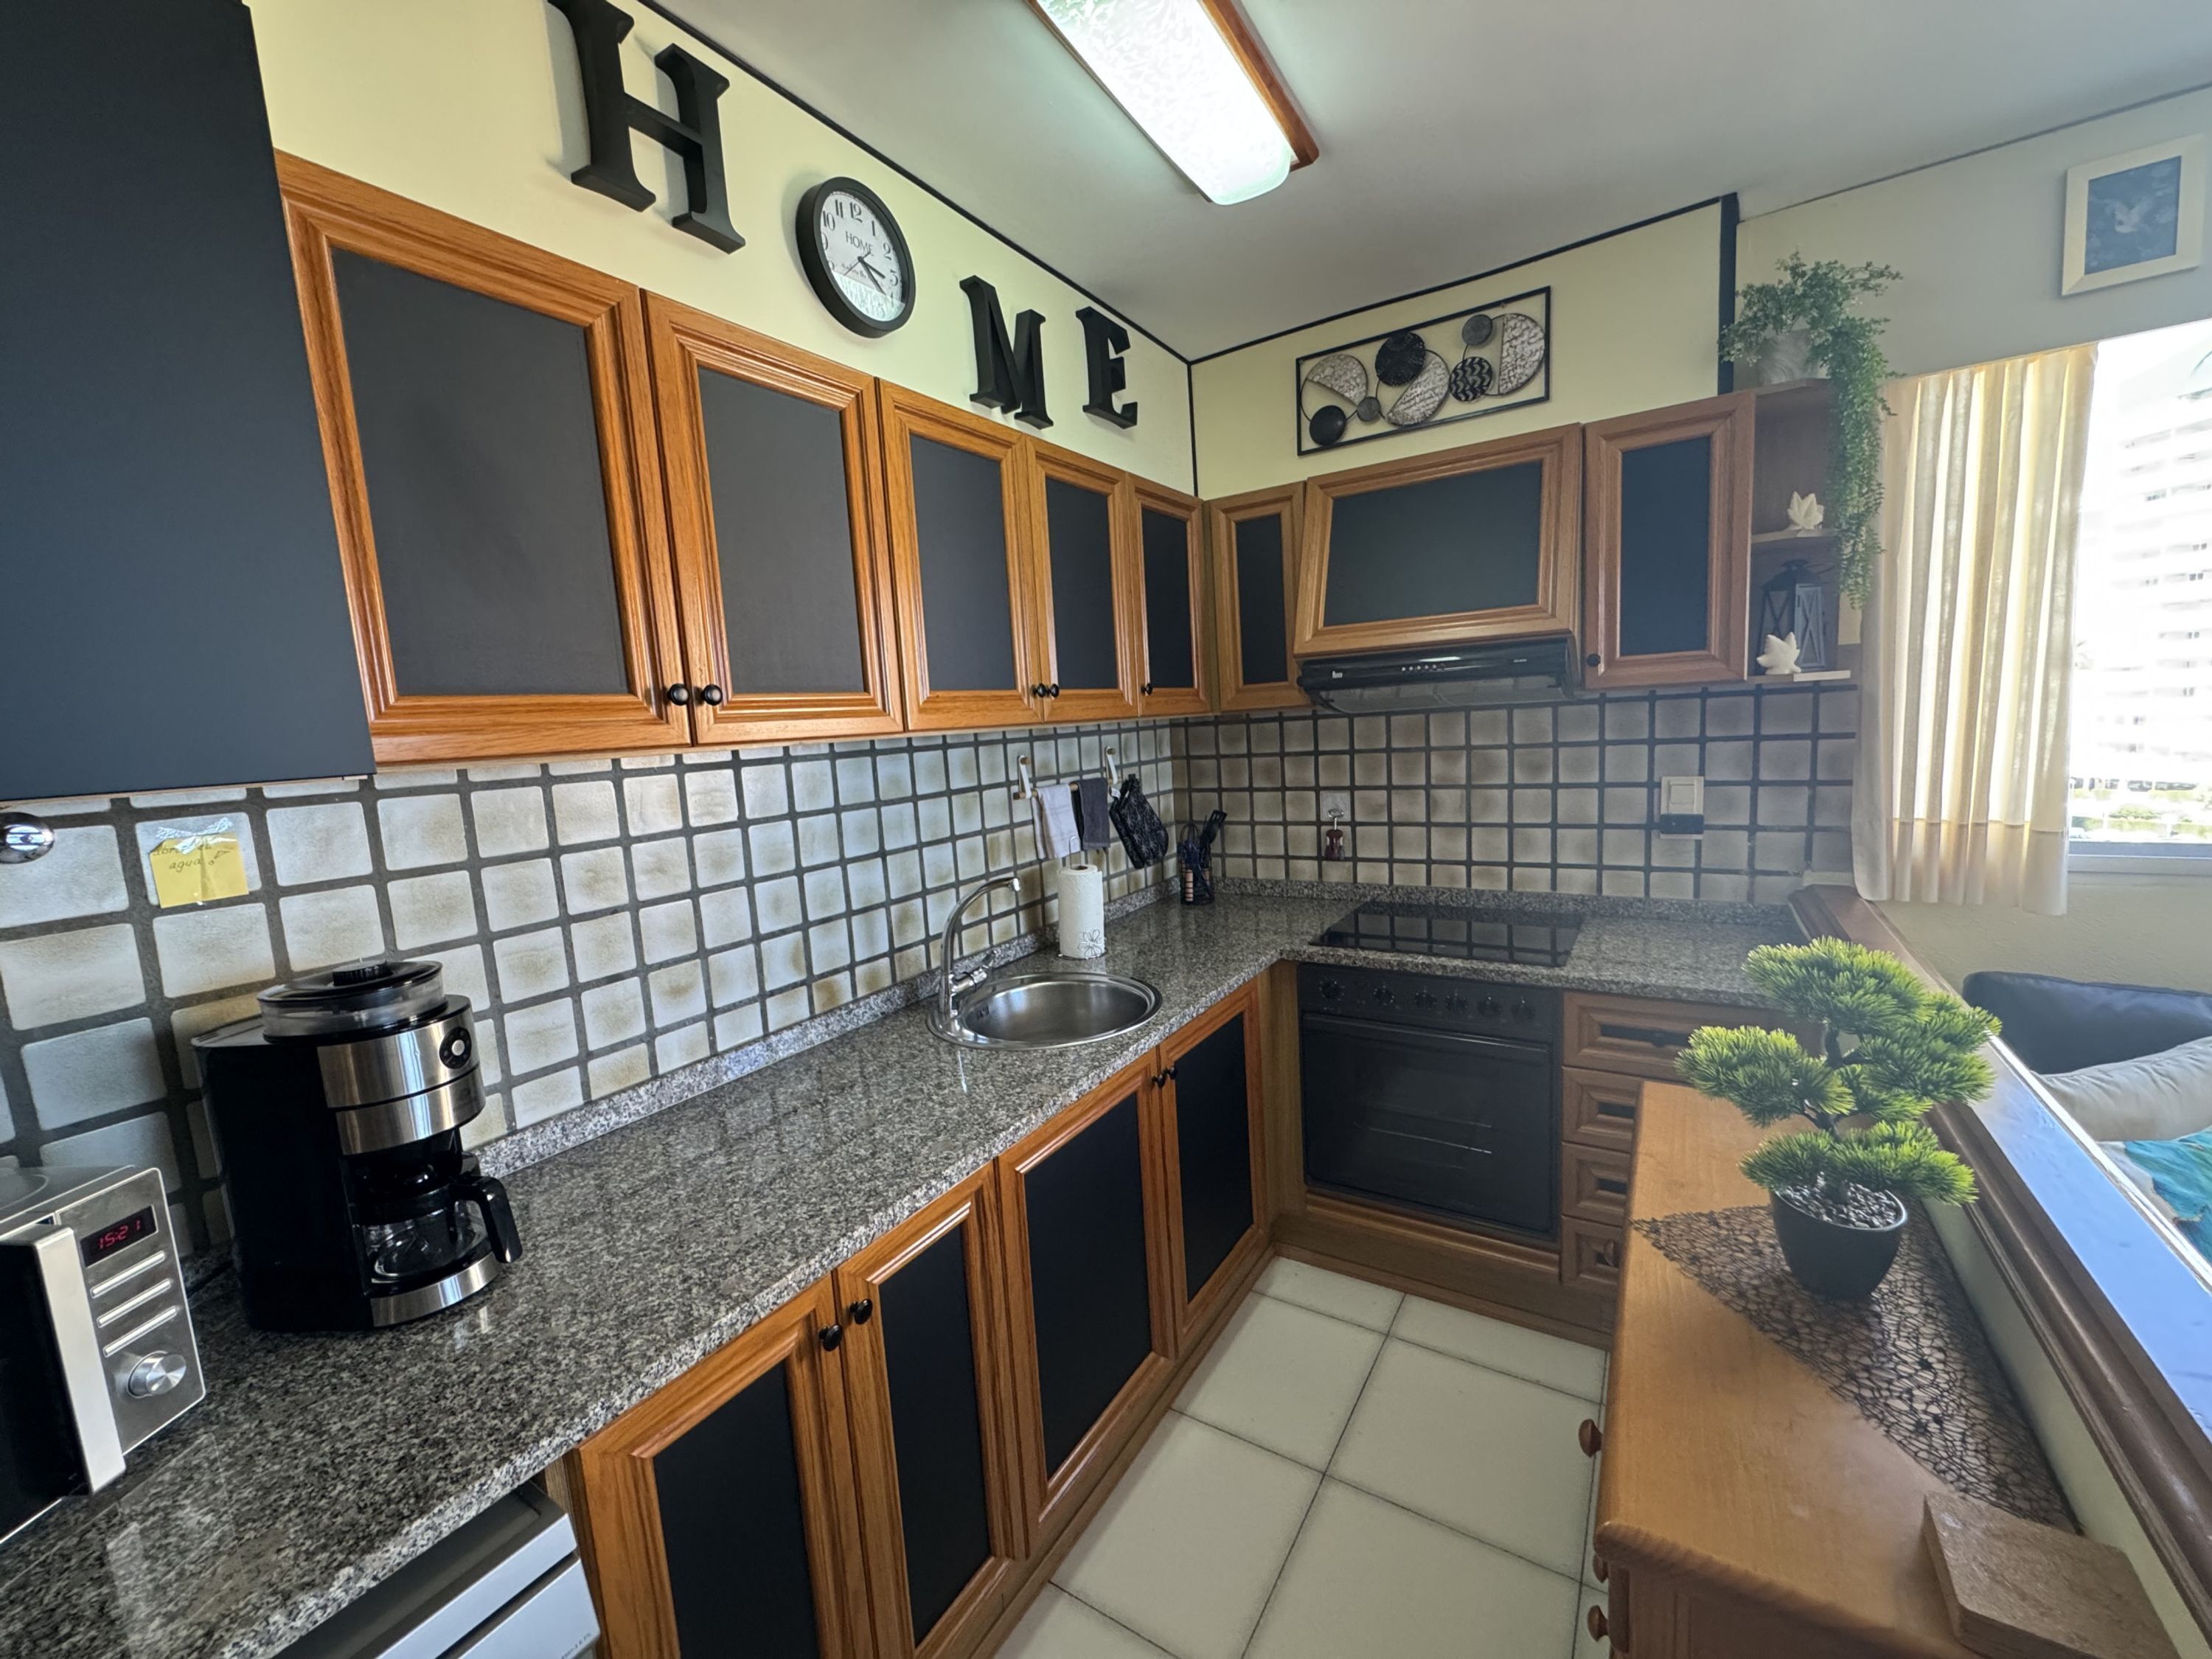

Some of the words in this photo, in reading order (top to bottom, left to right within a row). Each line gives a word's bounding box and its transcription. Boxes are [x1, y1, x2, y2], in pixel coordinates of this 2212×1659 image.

[835, 198, 844, 219] 11
[849, 201, 863, 223] 12
[822, 210, 836, 232] 10
[845, 230, 875, 257] HOME
[883, 241, 892, 260] 2
[889, 268, 899, 287] 3
[99, 1220, 141, 1250] 15:21
